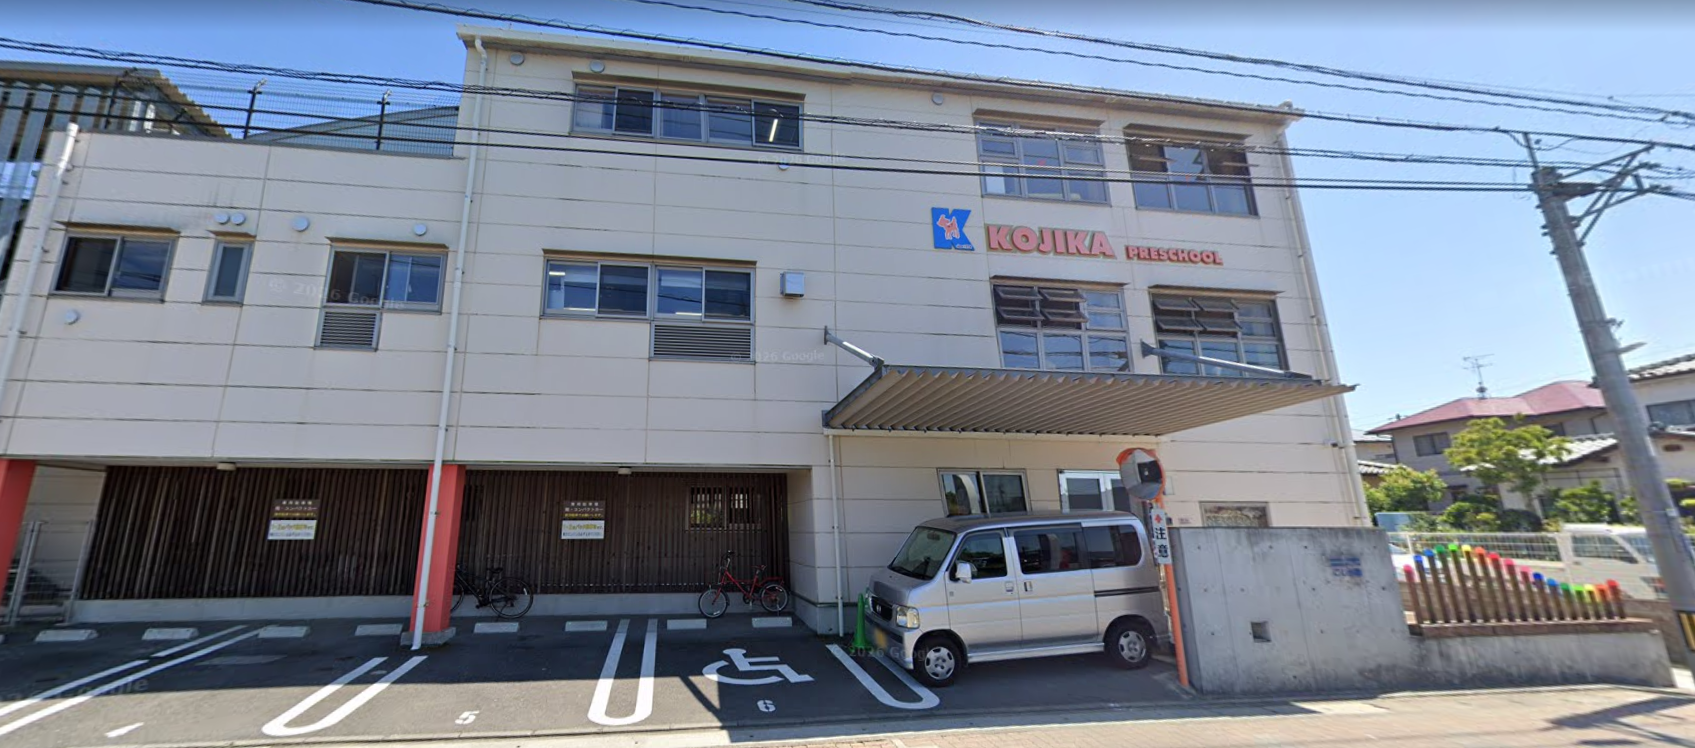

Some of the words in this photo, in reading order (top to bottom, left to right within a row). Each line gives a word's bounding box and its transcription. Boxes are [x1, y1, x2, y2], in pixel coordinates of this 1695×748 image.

[985, 224, 1116, 259] KOJIKA
[1125, 245, 1224, 266] PRESCHOOL
[1155, 527, 1169, 558] 注意
[455, 710, 480, 725] 5
[757, 700, 776, 712] 6
